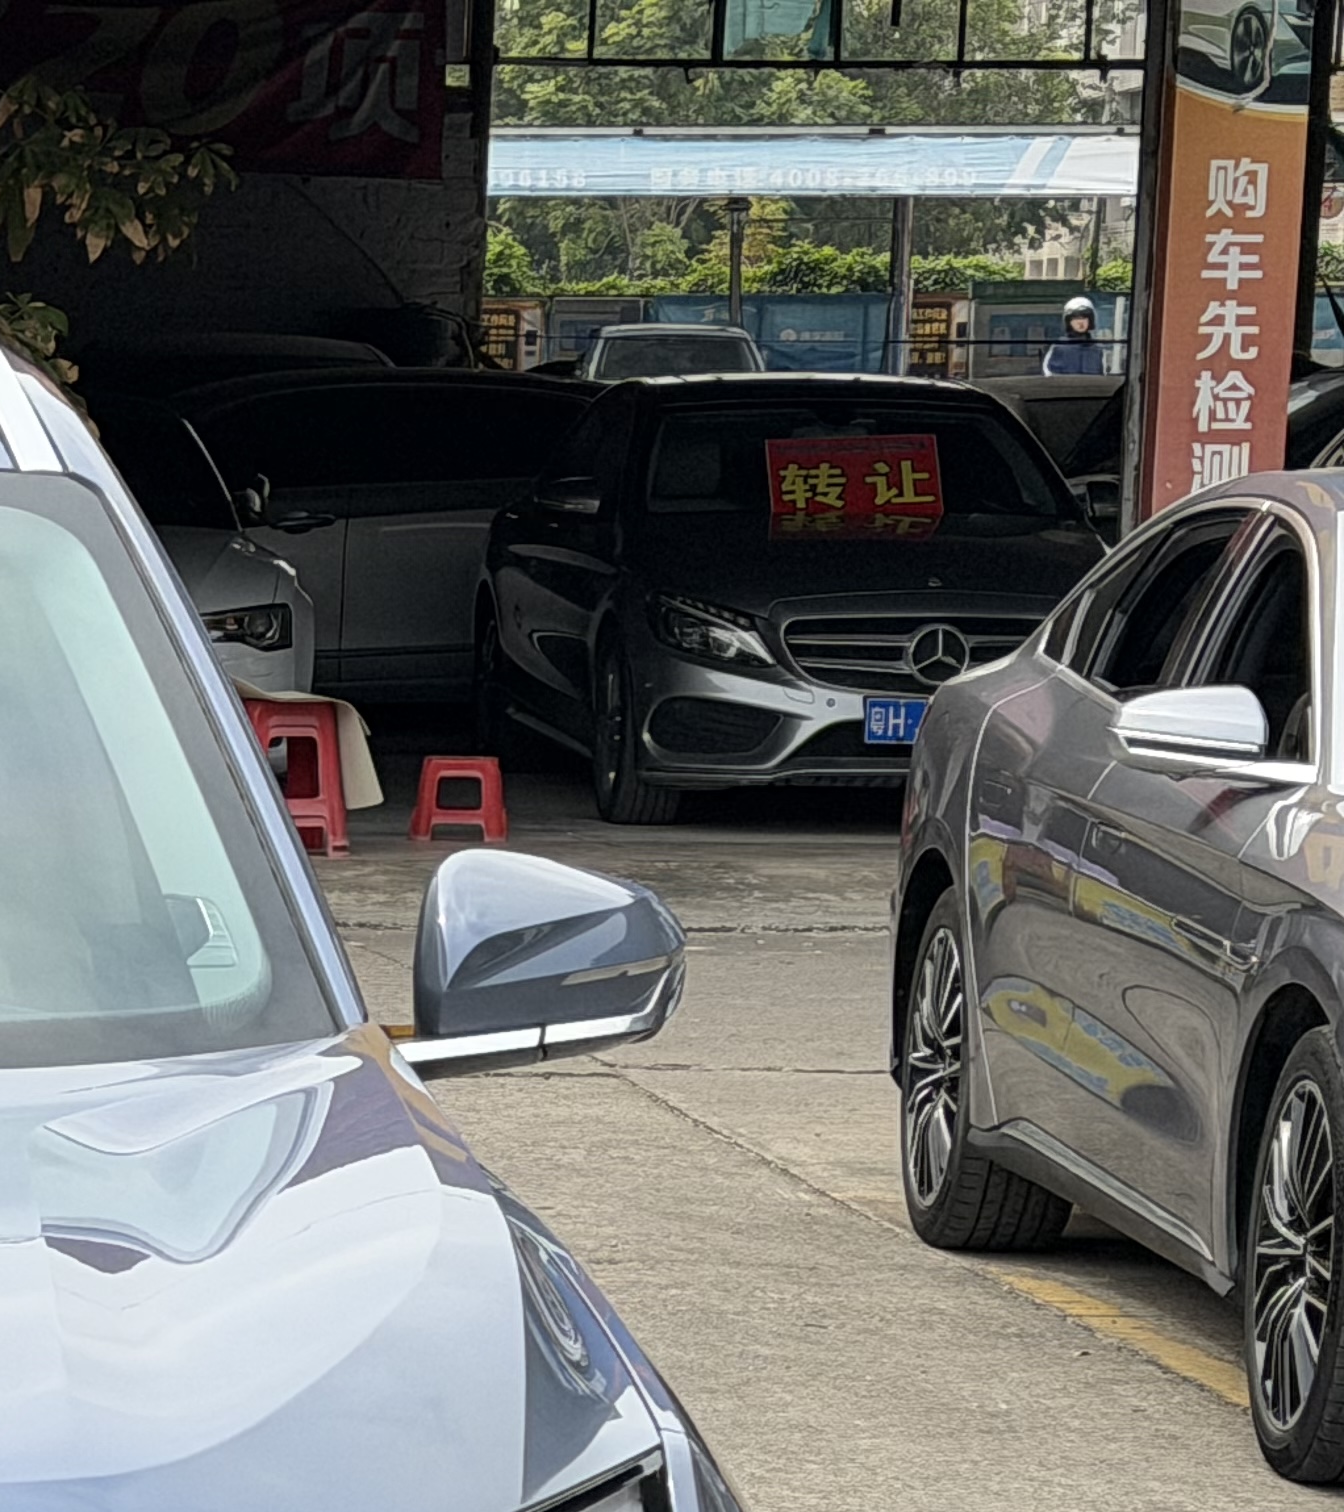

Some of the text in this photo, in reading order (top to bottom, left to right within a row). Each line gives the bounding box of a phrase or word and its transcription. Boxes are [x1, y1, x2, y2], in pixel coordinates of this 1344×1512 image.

[1190, 156, 1270, 493] 购车先检测
[778, 458, 938, 510] 转让
